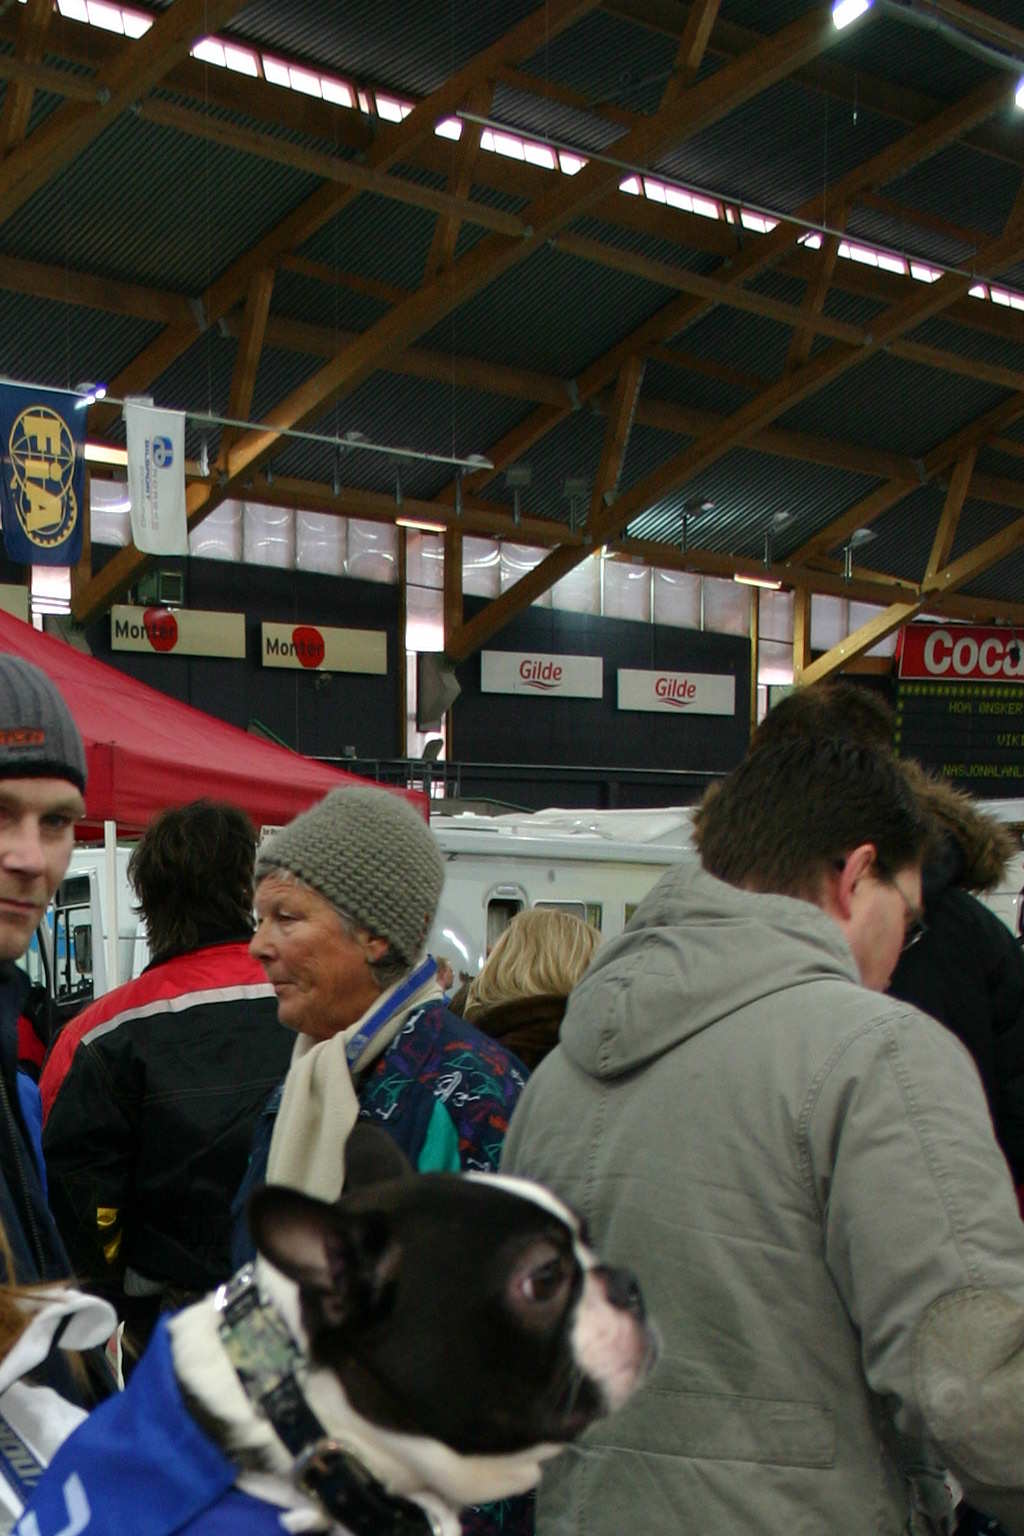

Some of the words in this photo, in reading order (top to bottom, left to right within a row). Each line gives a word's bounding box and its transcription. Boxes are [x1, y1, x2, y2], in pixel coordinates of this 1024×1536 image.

[114, 620, 175, 640] Monter
[266, 637, 323, 657] Monter
[519, 660, 563, 681] Gilde
[655, 677, 697, 698] Gilde
